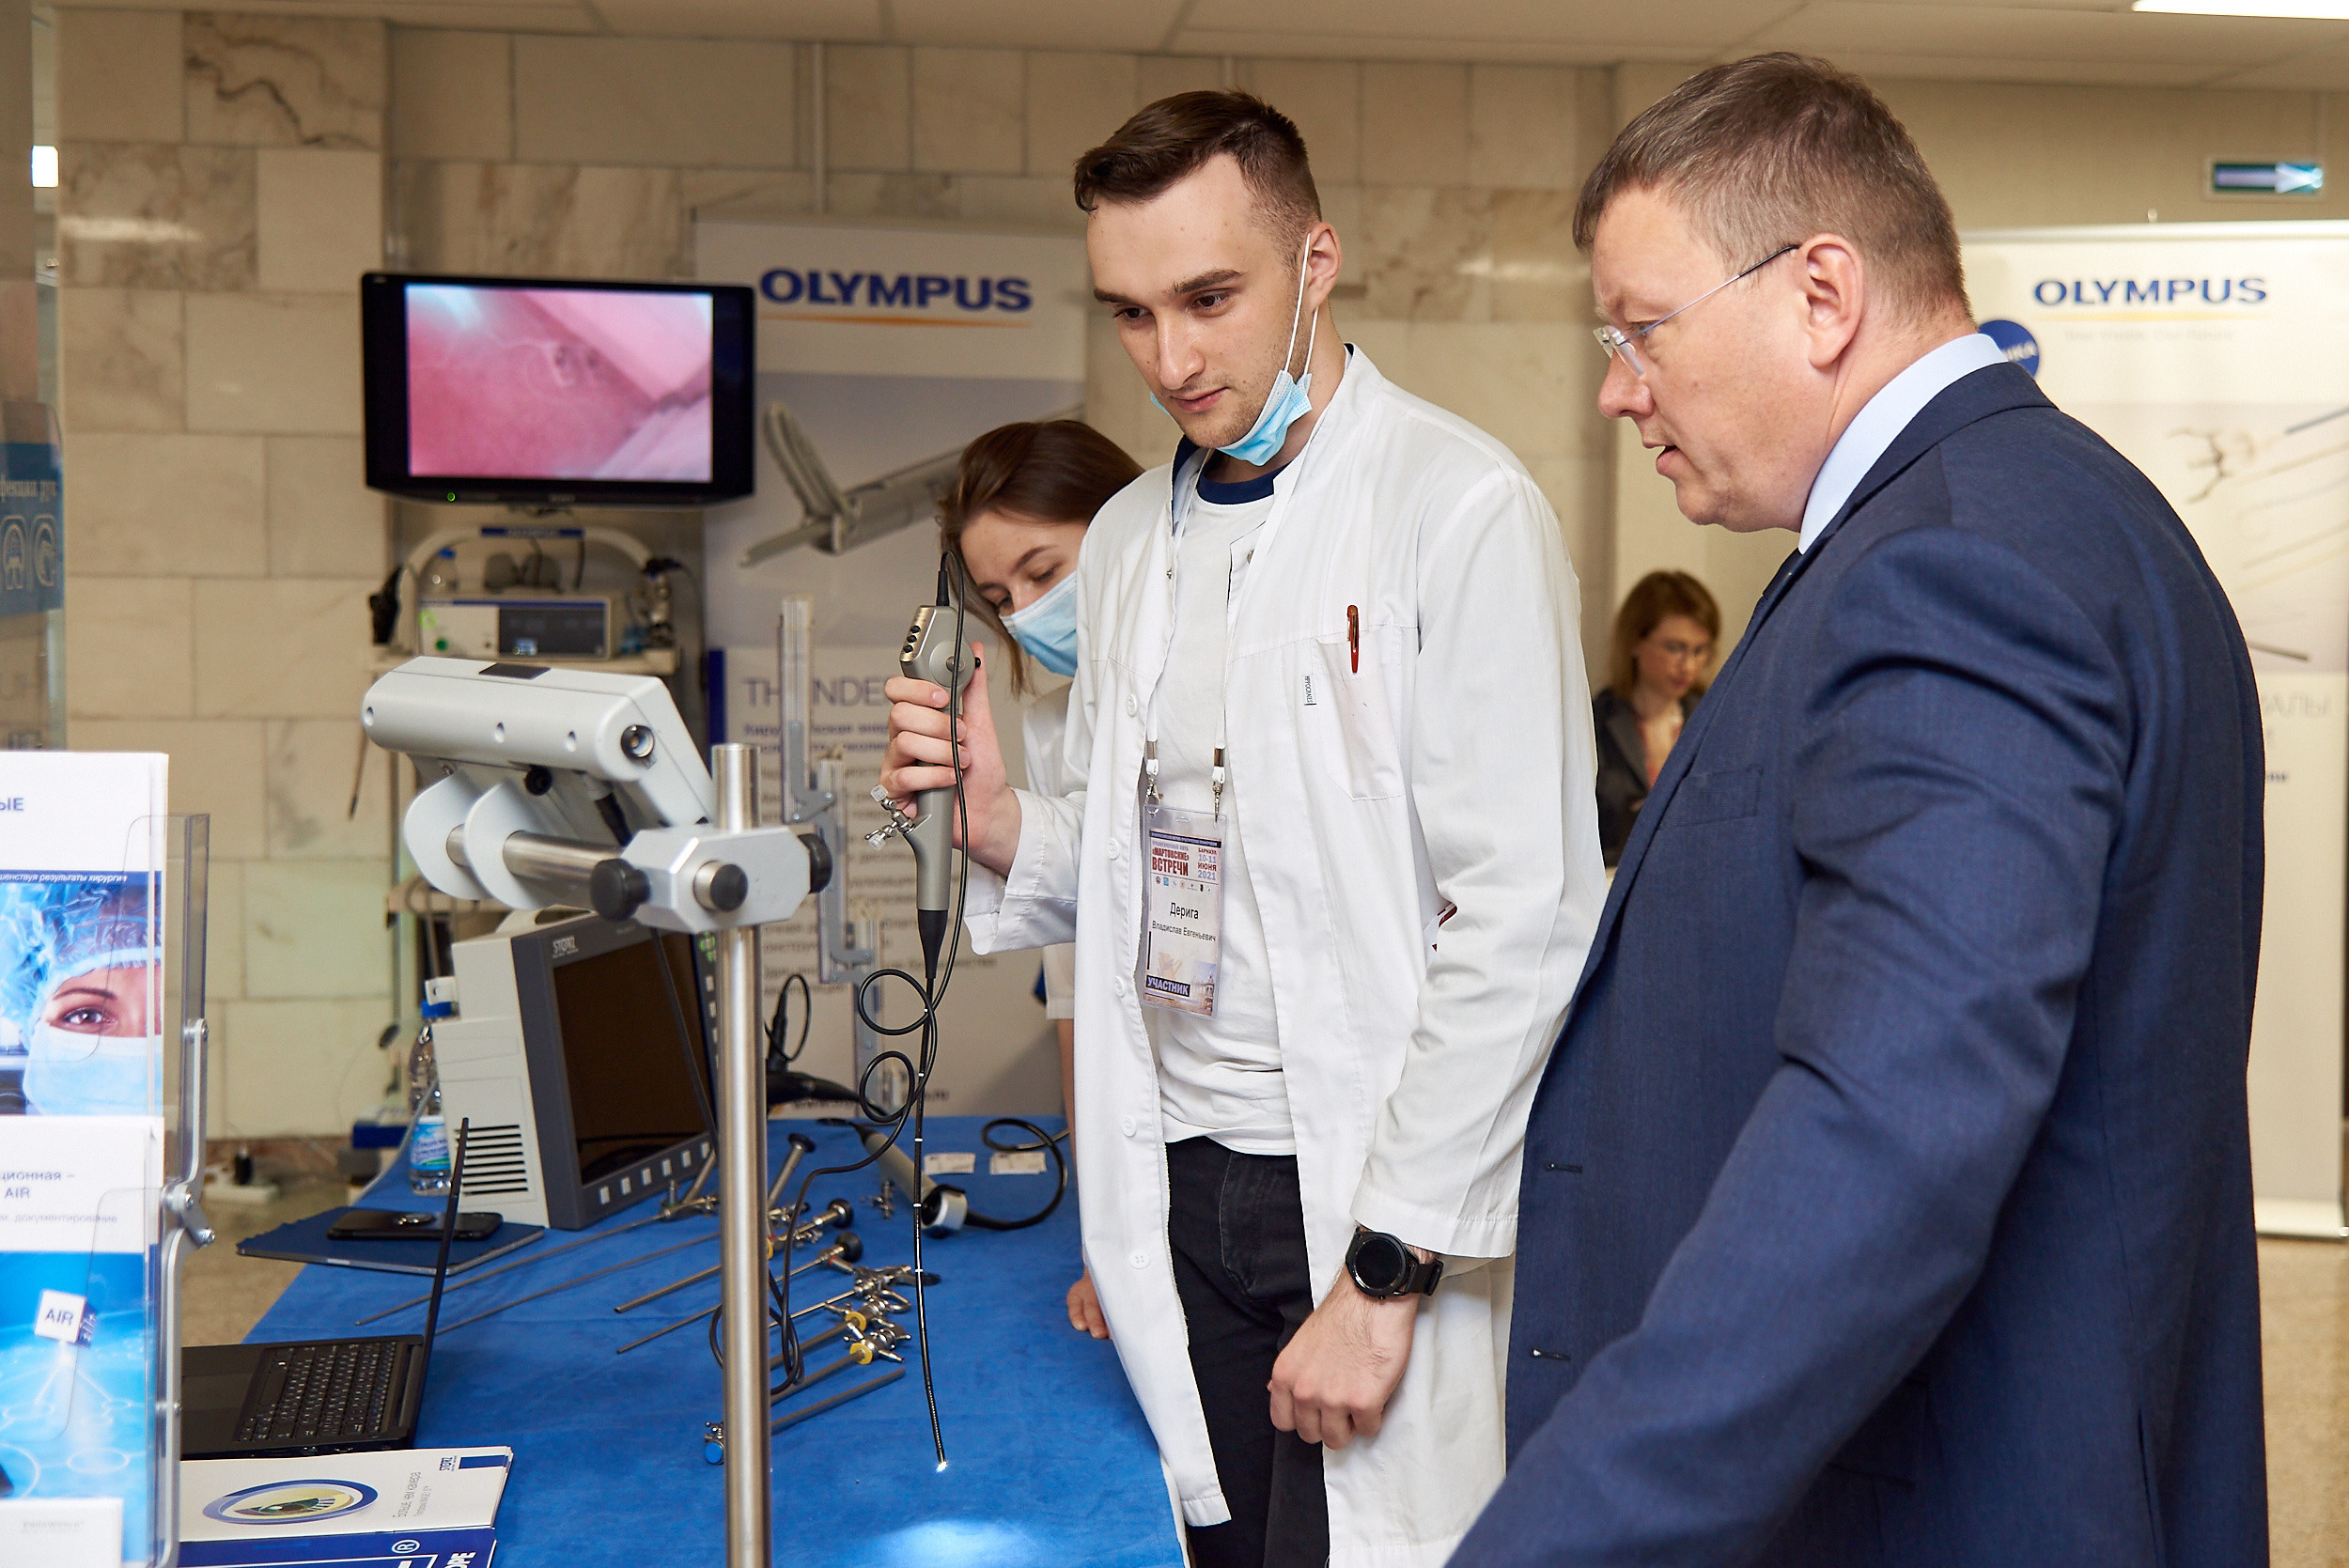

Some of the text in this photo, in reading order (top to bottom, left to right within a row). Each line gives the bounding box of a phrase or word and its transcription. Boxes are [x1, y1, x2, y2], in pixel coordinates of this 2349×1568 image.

[760, 266, 1033, 313] OLYMPUS
[2034, 277, 2267, 306] OLYMPUS
[1152, 856, 1189, 877] ВСТРЕЧИ
[1198, 862, 1217, 871] ИЮНЯ
[1199, 853, 1217, 863] 10-11
[39, 874, 86, 883] результаты
[88, 875, 128, 884] хирургии
[1198, 870, 1217, 880] 2021
[1170, 902, 1199, 920] Дерига
[1152, 920, 1217, 942] Владислав Евгеньевич
[552, 936, 576, 955] STORZ
[1147, 975, 1189, 996] УЧАСТНИК
[5, 1187, 30, 1198] AIR
[45, 1309, 74, 1326] AIR
[401, 1471, 422, 1492] камера
